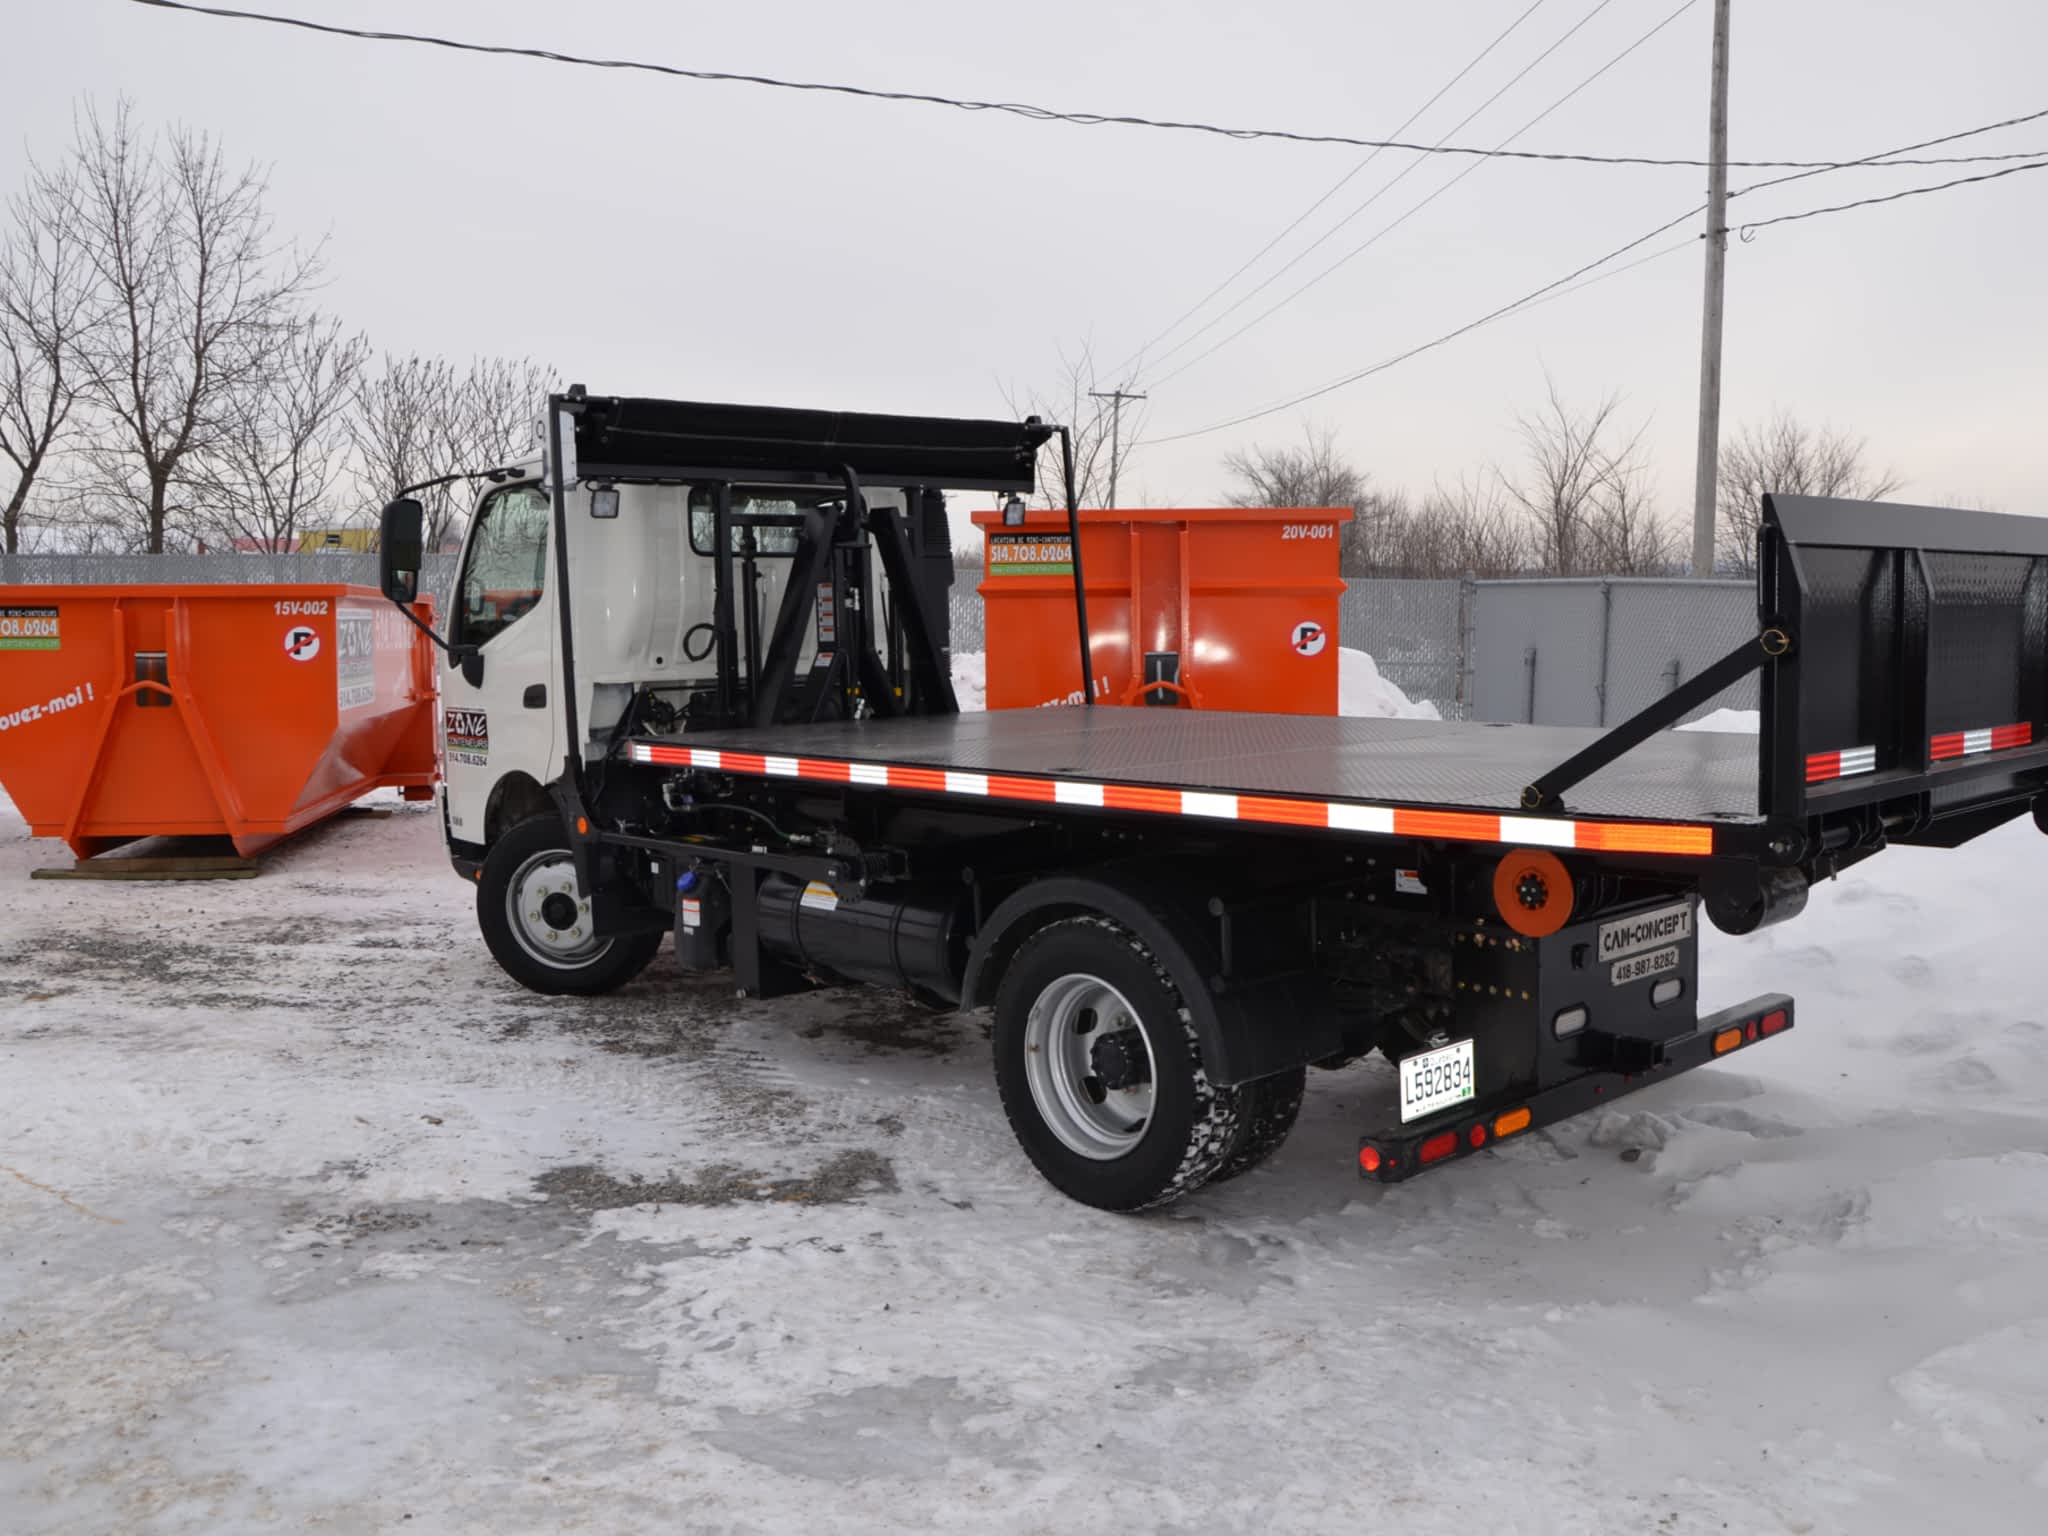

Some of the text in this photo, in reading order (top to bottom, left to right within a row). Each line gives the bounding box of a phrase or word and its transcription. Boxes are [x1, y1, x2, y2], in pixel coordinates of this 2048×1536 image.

[1281, 525, 1334, 540] 20V-001
[991, 545, 1072, 562] 514.708.6264
[274, 600, 329, 616] 15V-002
[447, 712, 486, 737] ZONE
[1604, 911, 1688, 952] CAM-CONCEPT
[1616, 951, 1676, 980] 418-987-8282
[1405, 1055, 1471, 1106] L592834
